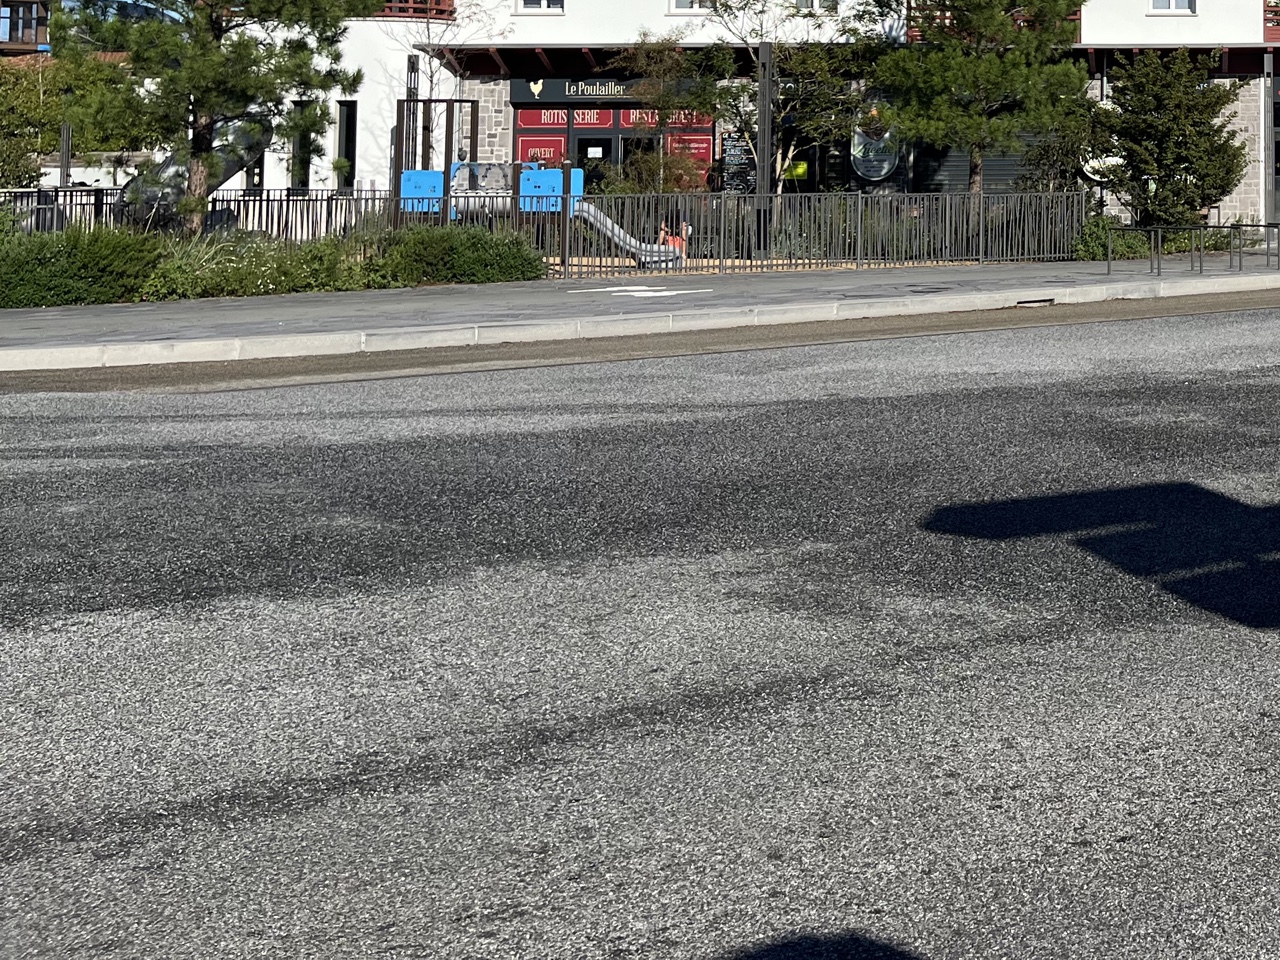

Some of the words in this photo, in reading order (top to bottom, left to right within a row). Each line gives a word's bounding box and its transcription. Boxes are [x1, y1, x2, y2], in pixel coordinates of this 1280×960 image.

[565, 81, 577, 95] Le
[578, 81, 626, 95] Poulailler
[541, 109, 568, 124] ROTIS
[573, 109, 600, 124] SERIE
